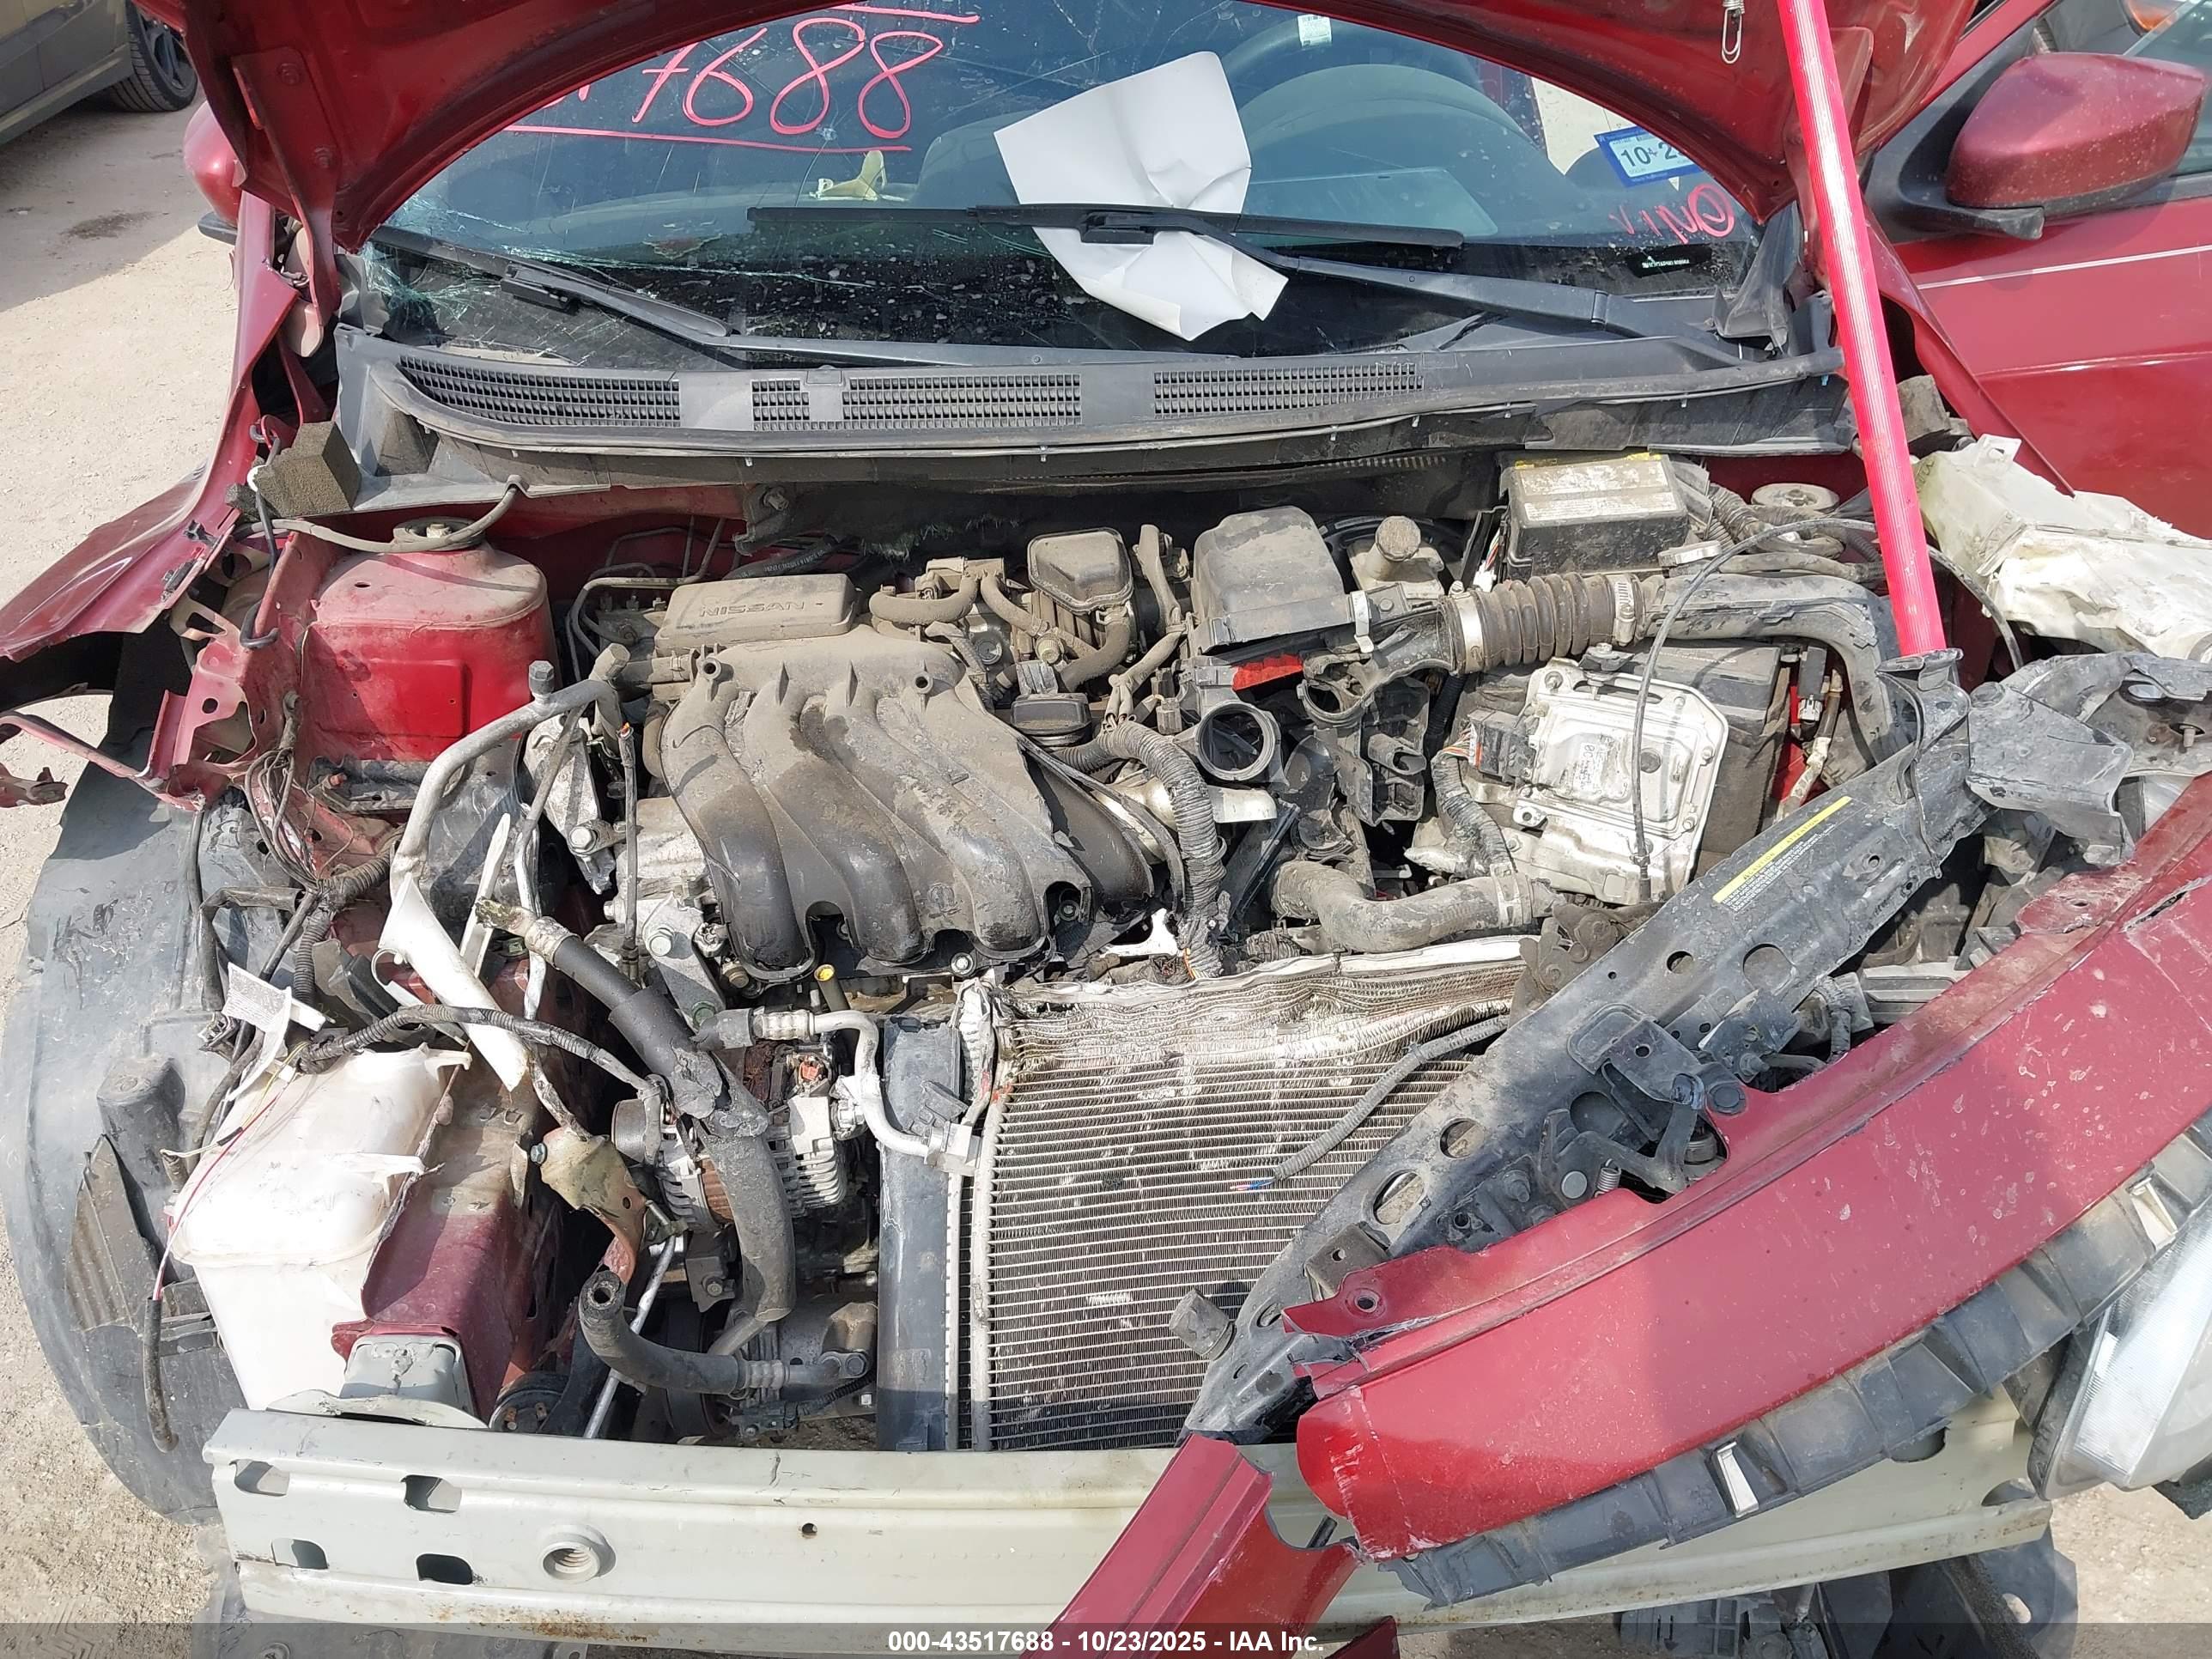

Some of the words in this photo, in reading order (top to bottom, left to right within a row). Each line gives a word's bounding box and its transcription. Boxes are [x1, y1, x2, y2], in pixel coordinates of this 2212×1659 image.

[543, 16, 944, 139] 7688
[1620, 145, 1651, 167] 10
[700, 600, 805, 617] NISSAN
